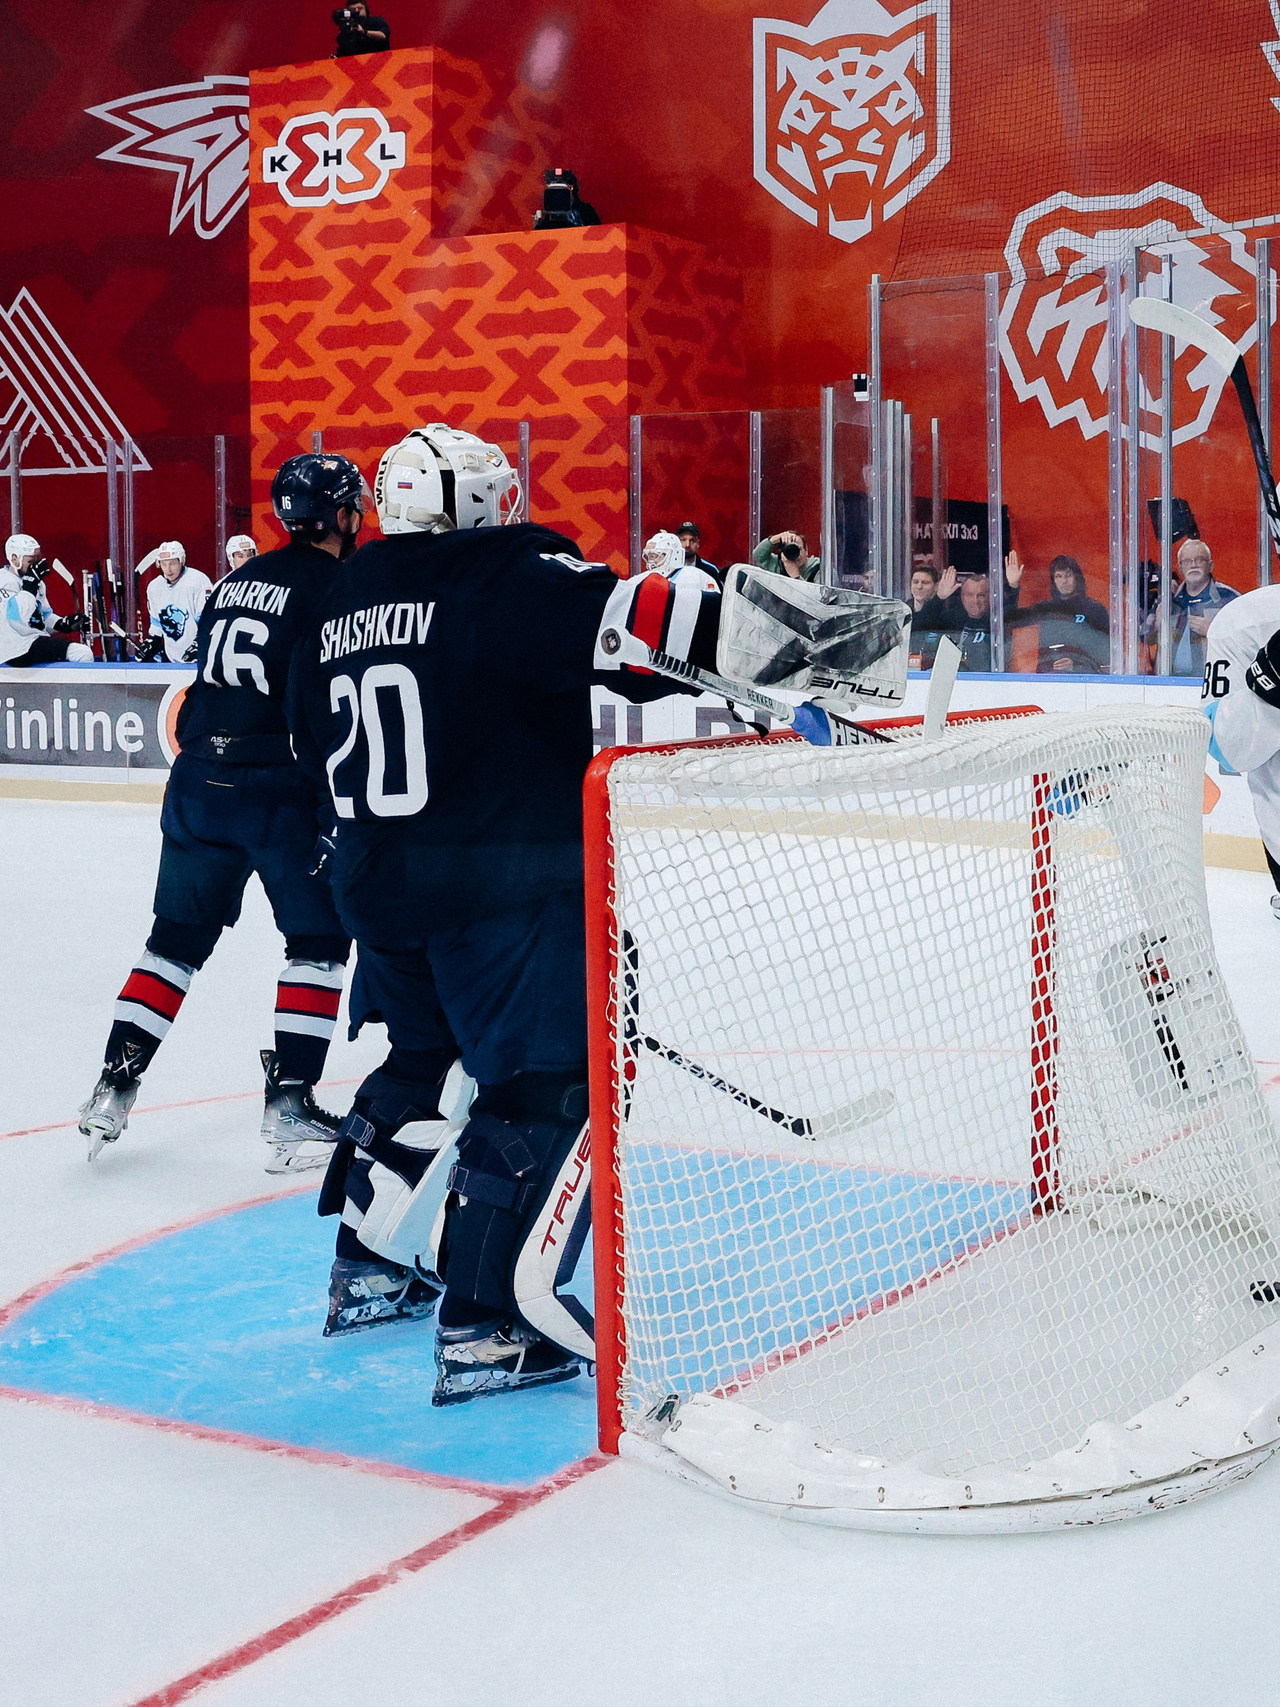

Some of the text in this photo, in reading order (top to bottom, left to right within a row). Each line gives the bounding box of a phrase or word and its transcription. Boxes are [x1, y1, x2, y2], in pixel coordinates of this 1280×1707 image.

[281, 496, 292, 510] 16
[214, 580, 292, 616] KHARKIN
[203, 616, 270, 696] 16
[320, 601, 436, 664] SHASHKOV
[810, 676, 904, 700] TRUE
[0, 697, 145, 753] inline
[326, 663, 429, 819] 20
[540, 1127, 592, 1256] TRUE
